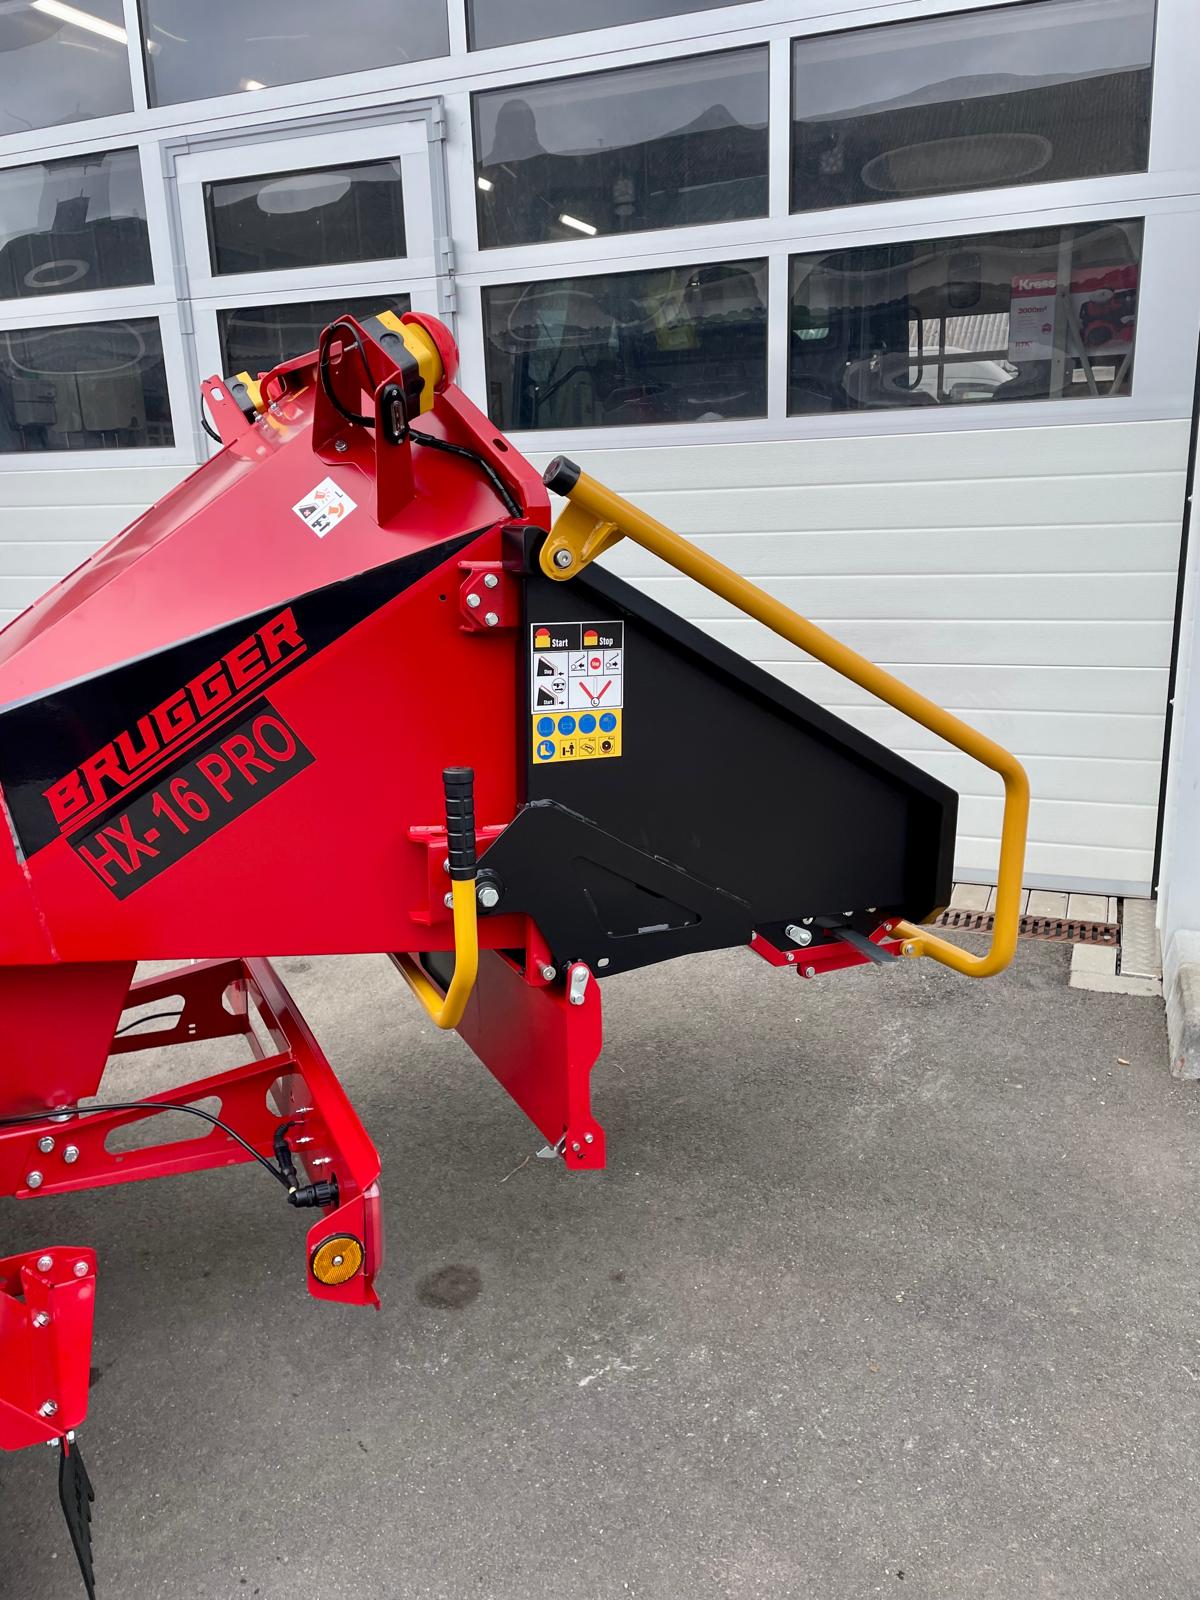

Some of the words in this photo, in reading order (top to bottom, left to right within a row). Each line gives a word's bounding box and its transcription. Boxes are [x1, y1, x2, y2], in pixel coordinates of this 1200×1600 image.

[1019, 279, 1056, 291] Kress
[551, 638, 569, 648] Start
[599, 637, 614, 647] Stop
[42, 607, 306, 825] BRUGGER
[77, 777, 211, 887] HX-16
[195, 714, 297, 803] PRO
